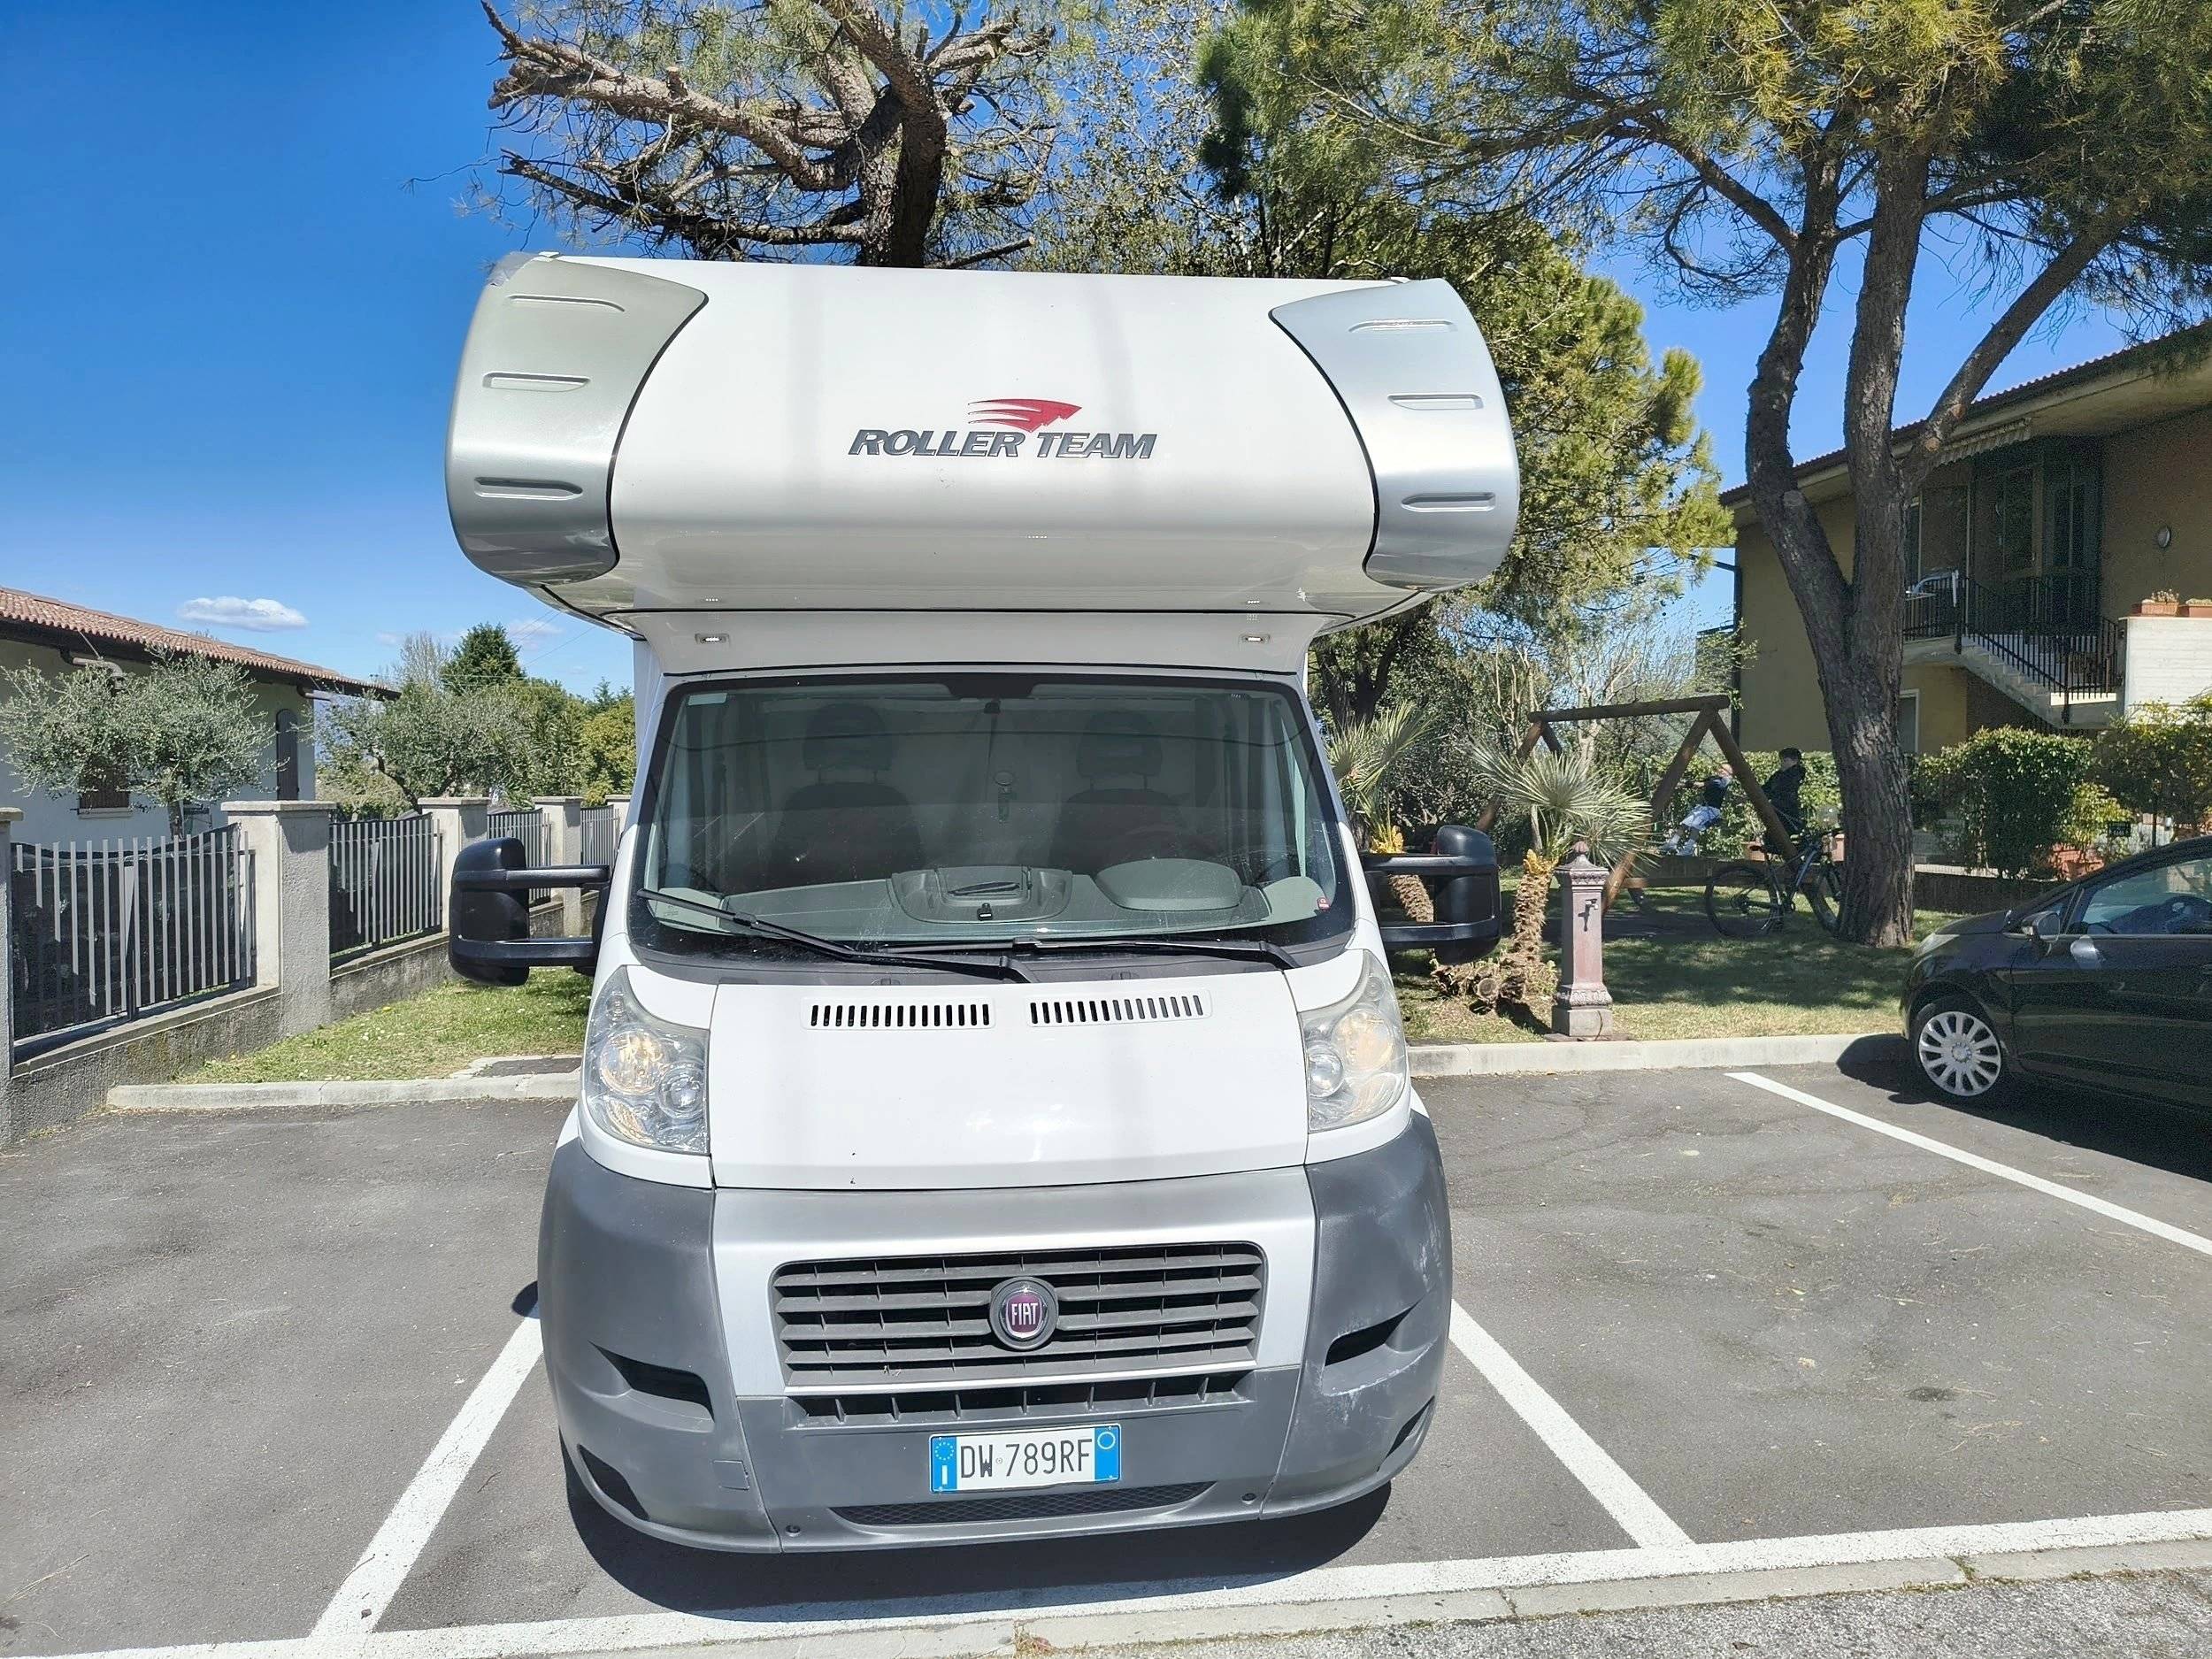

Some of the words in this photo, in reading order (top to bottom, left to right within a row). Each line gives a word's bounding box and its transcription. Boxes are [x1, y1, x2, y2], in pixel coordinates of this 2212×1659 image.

[849, 428, 1025, 457] ROLLER
[1036, 432, 1157, 459] TEAM
[1011, 1302, 1039, 1326] FIAT
